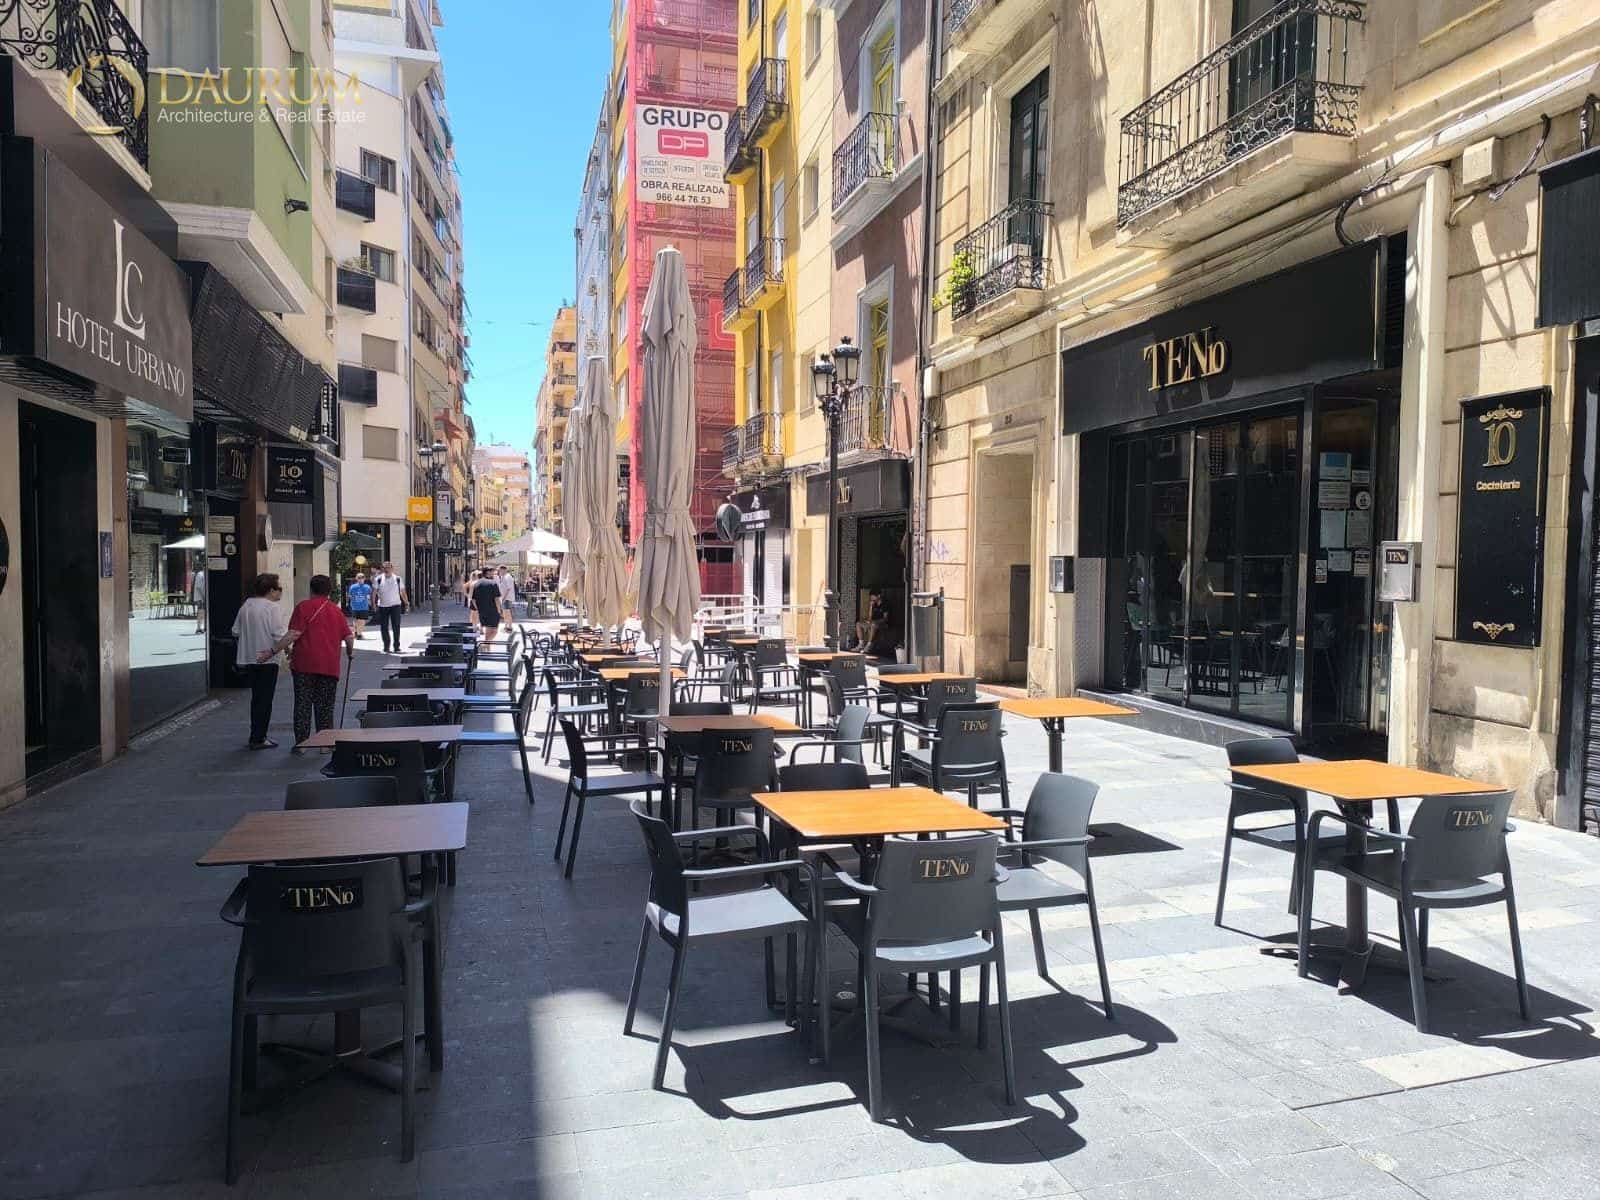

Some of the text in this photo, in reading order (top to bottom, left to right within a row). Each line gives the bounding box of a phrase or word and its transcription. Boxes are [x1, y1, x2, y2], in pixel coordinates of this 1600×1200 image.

[642, 107, 723, 131] GRUPO
[640, 180, 725, 195] OBRA REALIZADA
[674, 194, 685, 203] 44
[57, 301, 185, 397] HOTEL URBANO
[1482, 421, 1516, 467] 10
